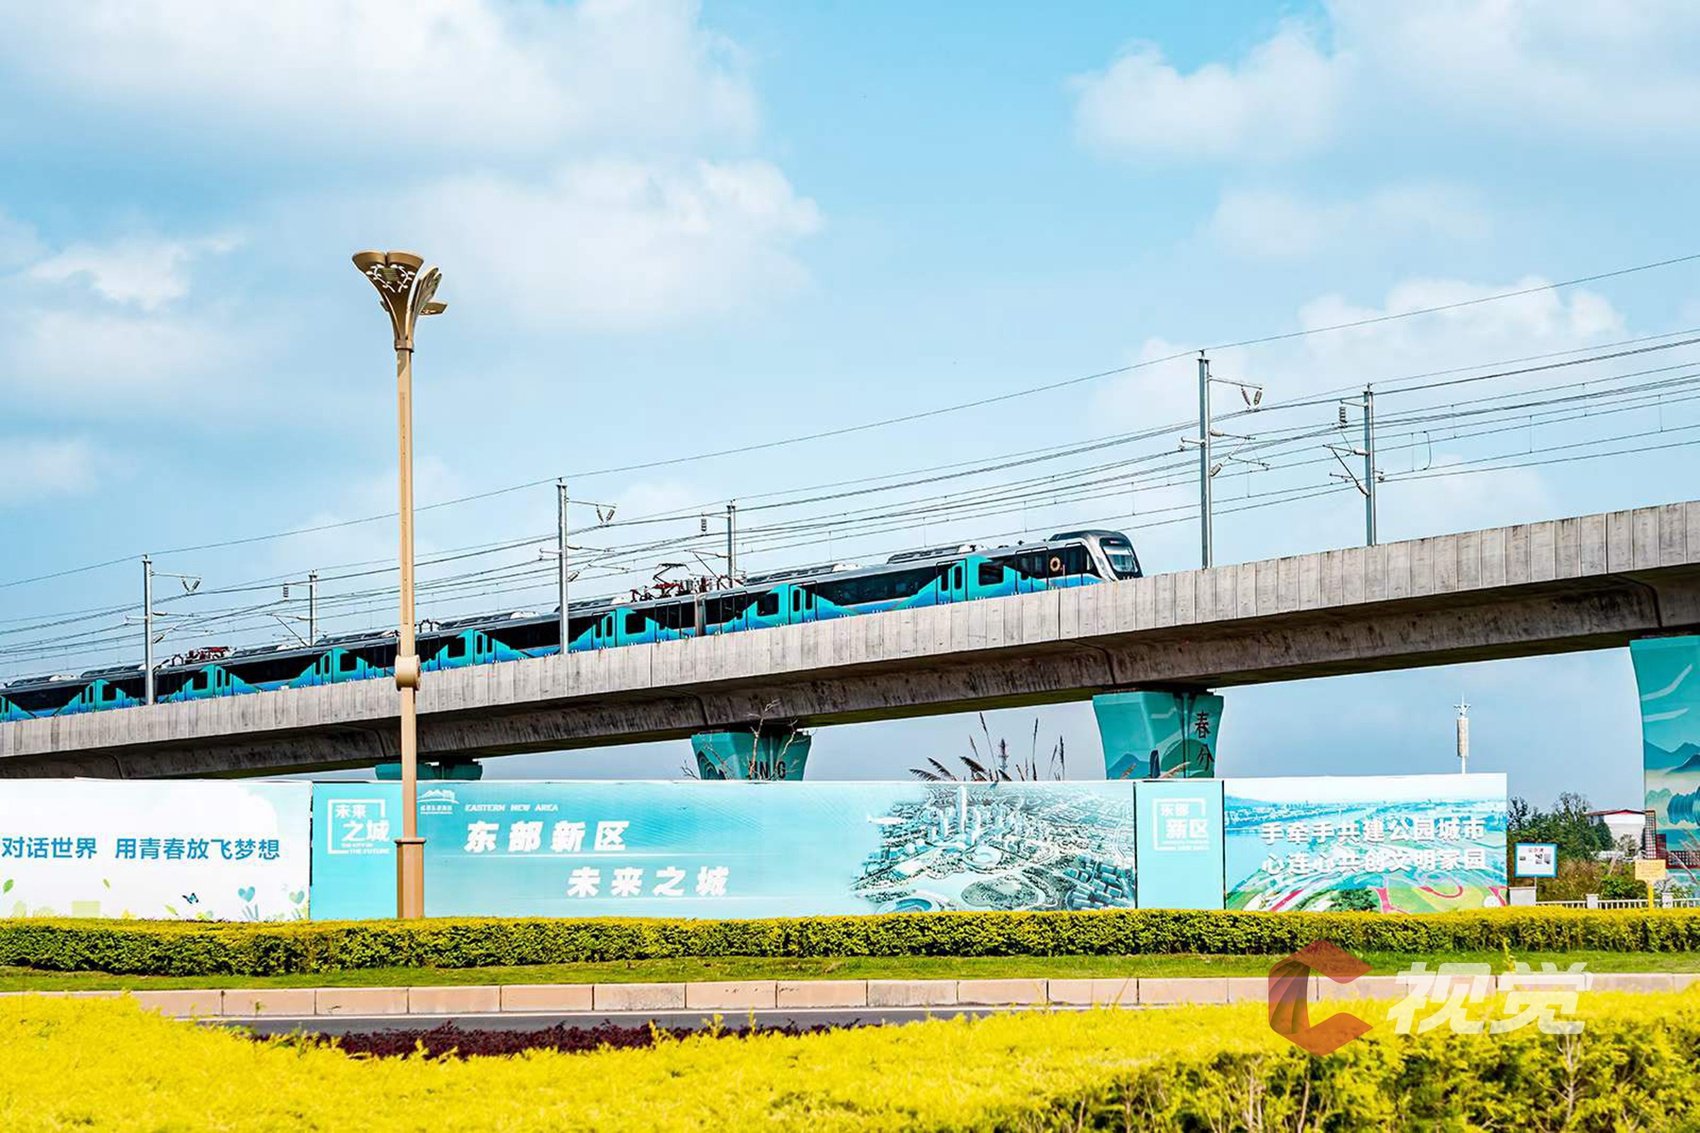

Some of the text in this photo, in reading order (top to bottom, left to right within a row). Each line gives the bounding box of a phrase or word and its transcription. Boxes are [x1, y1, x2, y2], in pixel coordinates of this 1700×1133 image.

[1195, 709, 1215, 772] 春分
[335, 804, 367, 819] 未来
[464, 803, 559, 812] EASTERN NEW AREA
[341, 819, 390, 842] 之城
[464, 820, 631, 853] 东部新区
[1165, 818, 1209, 839] 新区
[1261, 815, 1486, 846] 手牵手共建公园城市
[1, 837, 281, 861] 对话世界 用青春放飞梦想
[1261, 848, 1488, 876] 心连心共创文明家园
[566, 866, 730, 898] 未来之城
